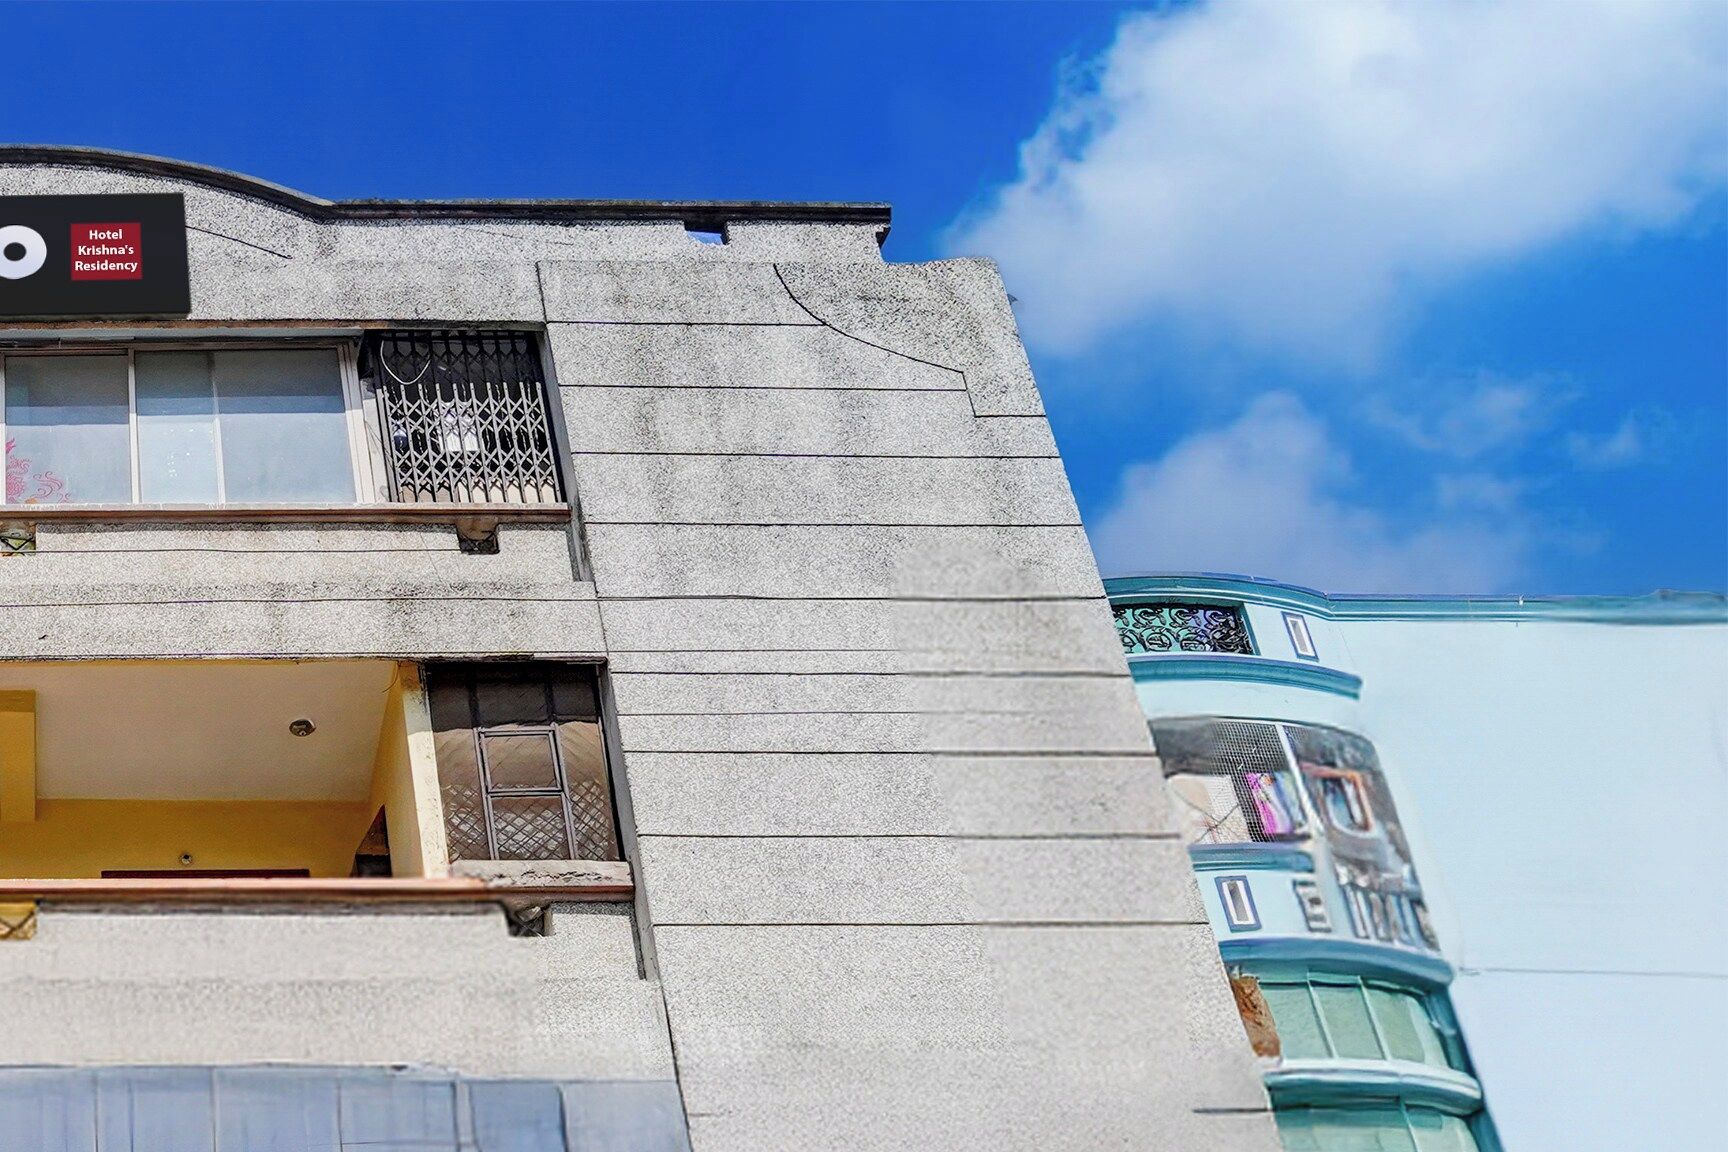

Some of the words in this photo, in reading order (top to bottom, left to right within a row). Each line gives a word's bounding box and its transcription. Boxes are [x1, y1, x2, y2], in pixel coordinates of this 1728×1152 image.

[89, 229, 123, 240] Hotel
[77, 245, 134, 256] Krishna's
[74, 260, 138, 273] Residency
